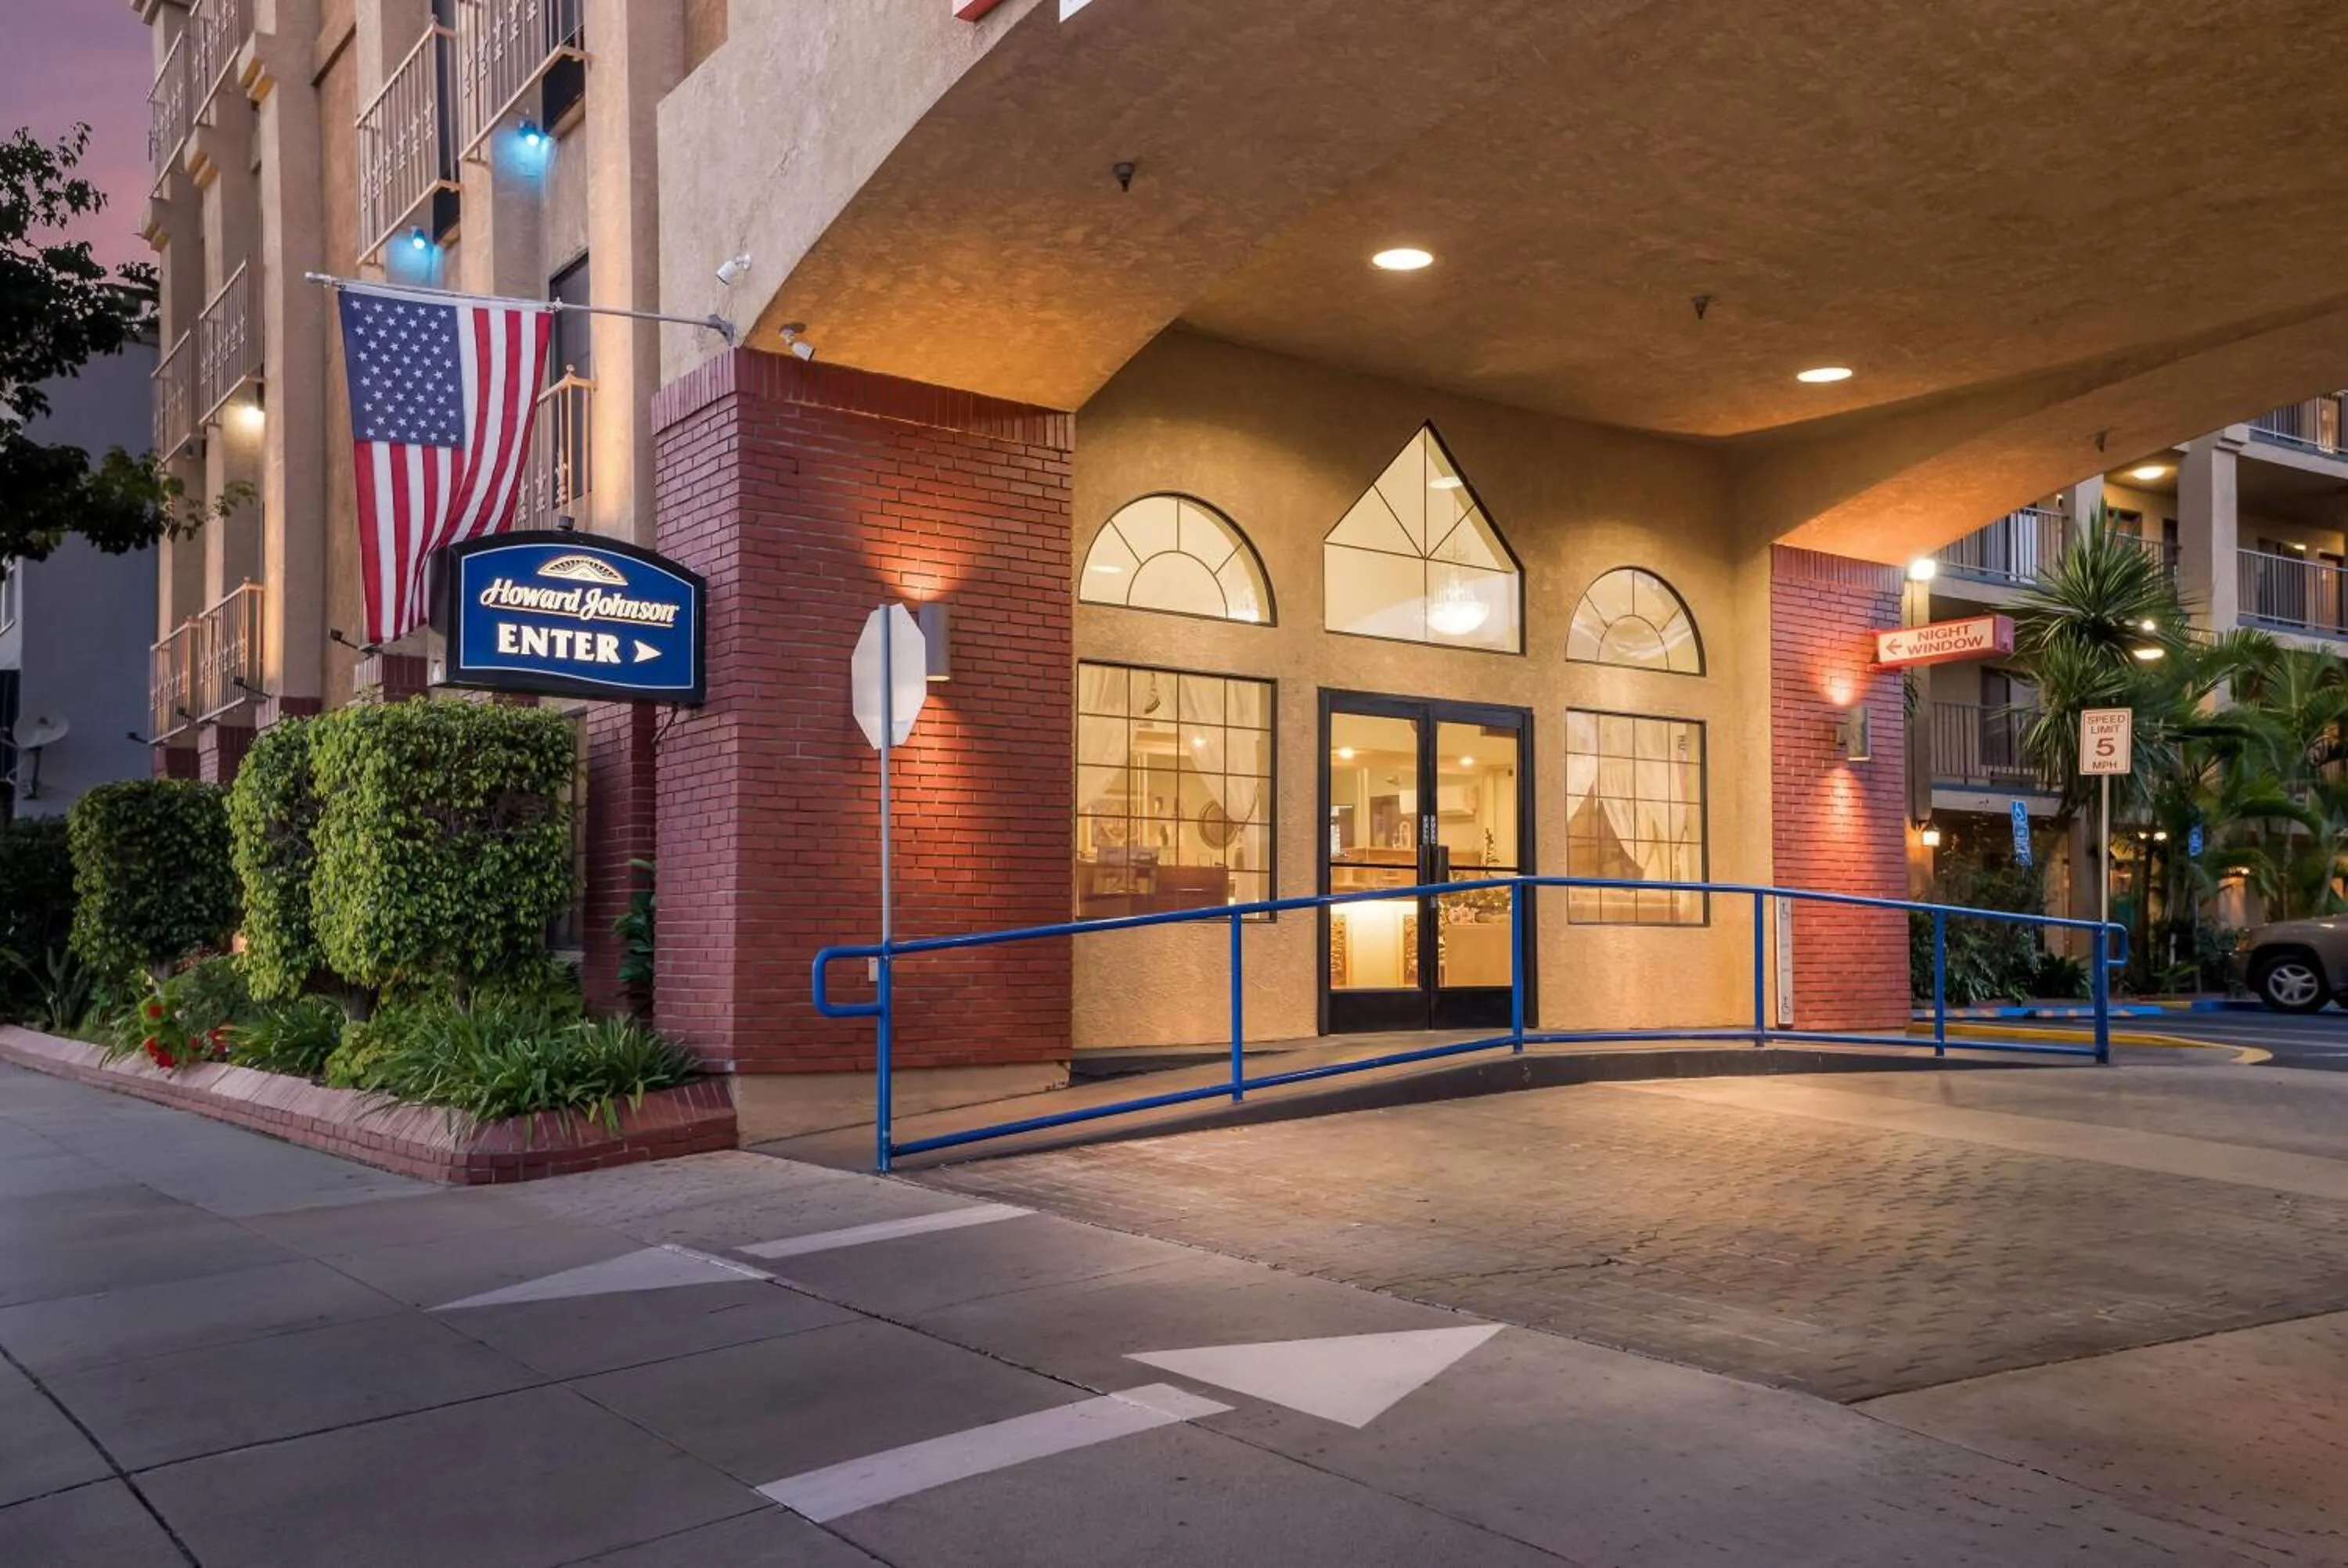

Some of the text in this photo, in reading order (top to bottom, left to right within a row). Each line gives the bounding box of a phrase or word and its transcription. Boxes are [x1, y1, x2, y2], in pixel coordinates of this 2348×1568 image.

[481, 578, 676, 621] Howard Johnson
[1918, 624, 1970, 642] NIGHT
[498, 623, 621, 664] ENTER
[1907, 635, 1984, 654] WINDOW
[2087, 714, 2126, 725] SPEED
[2091, 725, 2119, 734] LIMIT
[2096, 737, 2115, 756] 5
